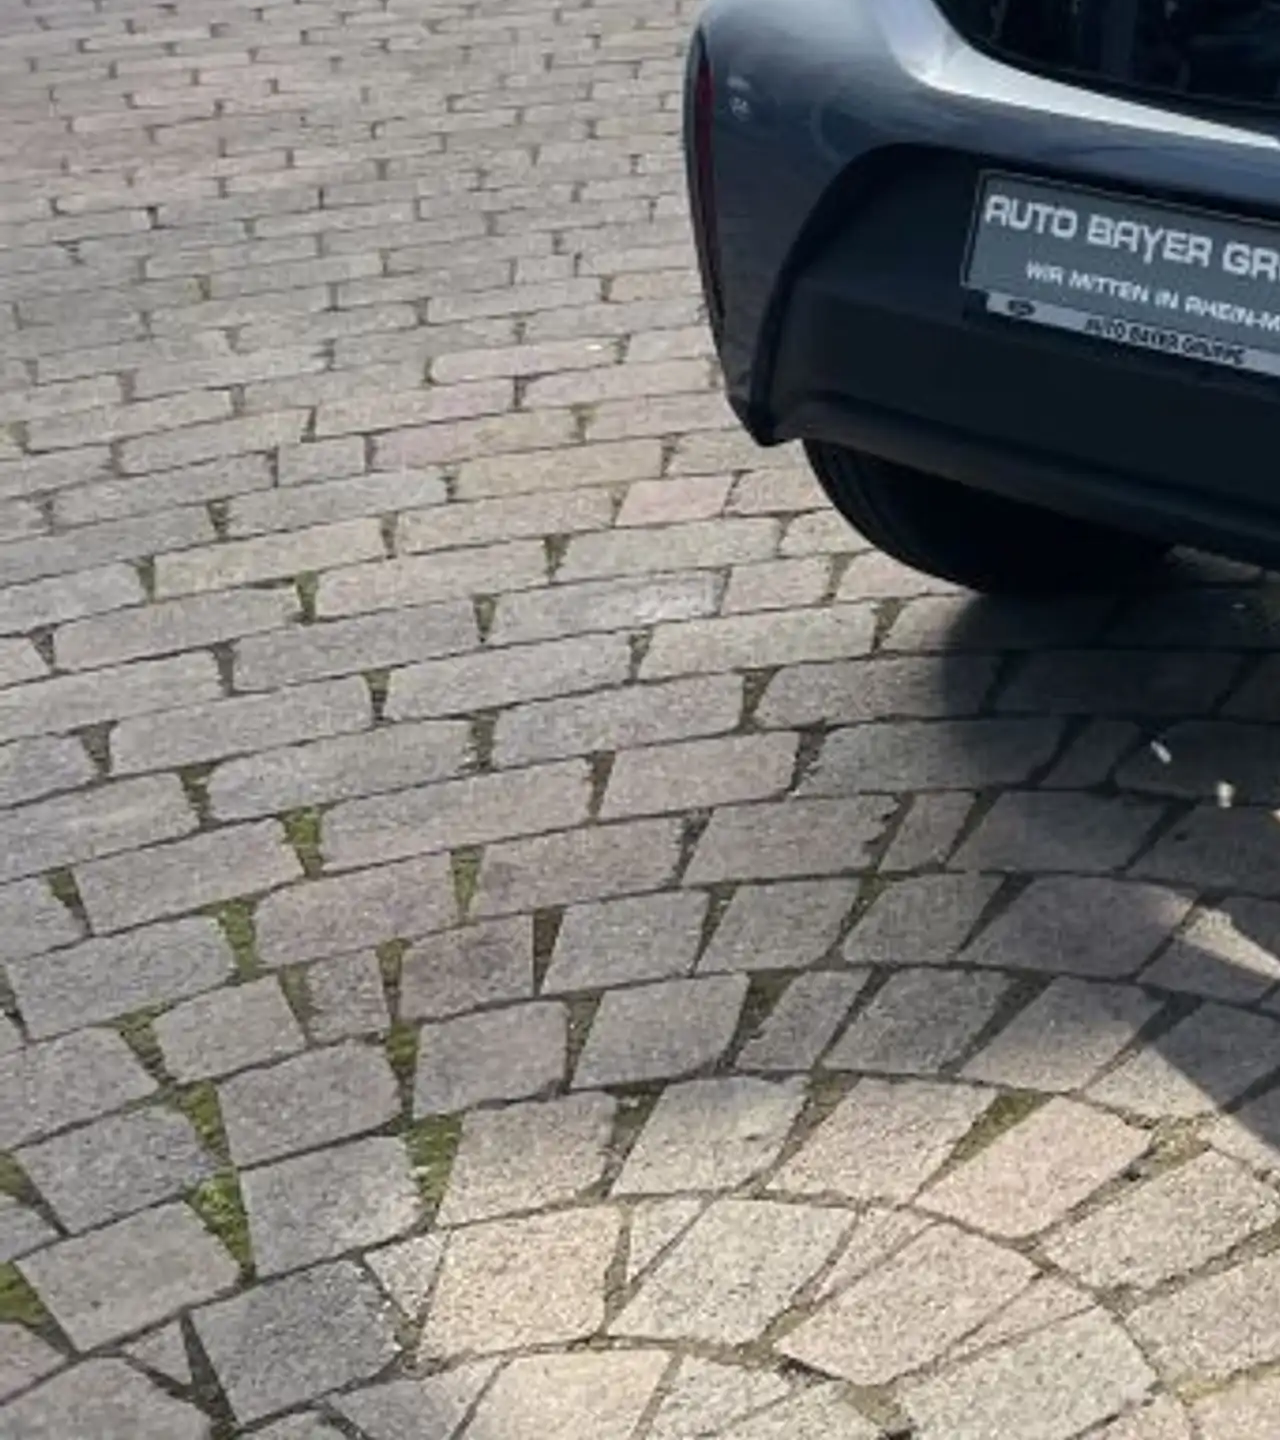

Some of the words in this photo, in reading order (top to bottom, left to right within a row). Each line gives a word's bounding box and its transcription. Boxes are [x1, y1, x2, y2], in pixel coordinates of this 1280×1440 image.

[985, 194, 1078, 240] AUTO
[1087, 214, 1213, 268] BAYER
[1026, 260, 1064, 287] WIR
[1069, 269, 1149, 303] MITTEN
[1154, 289, 1180, 310] IN
